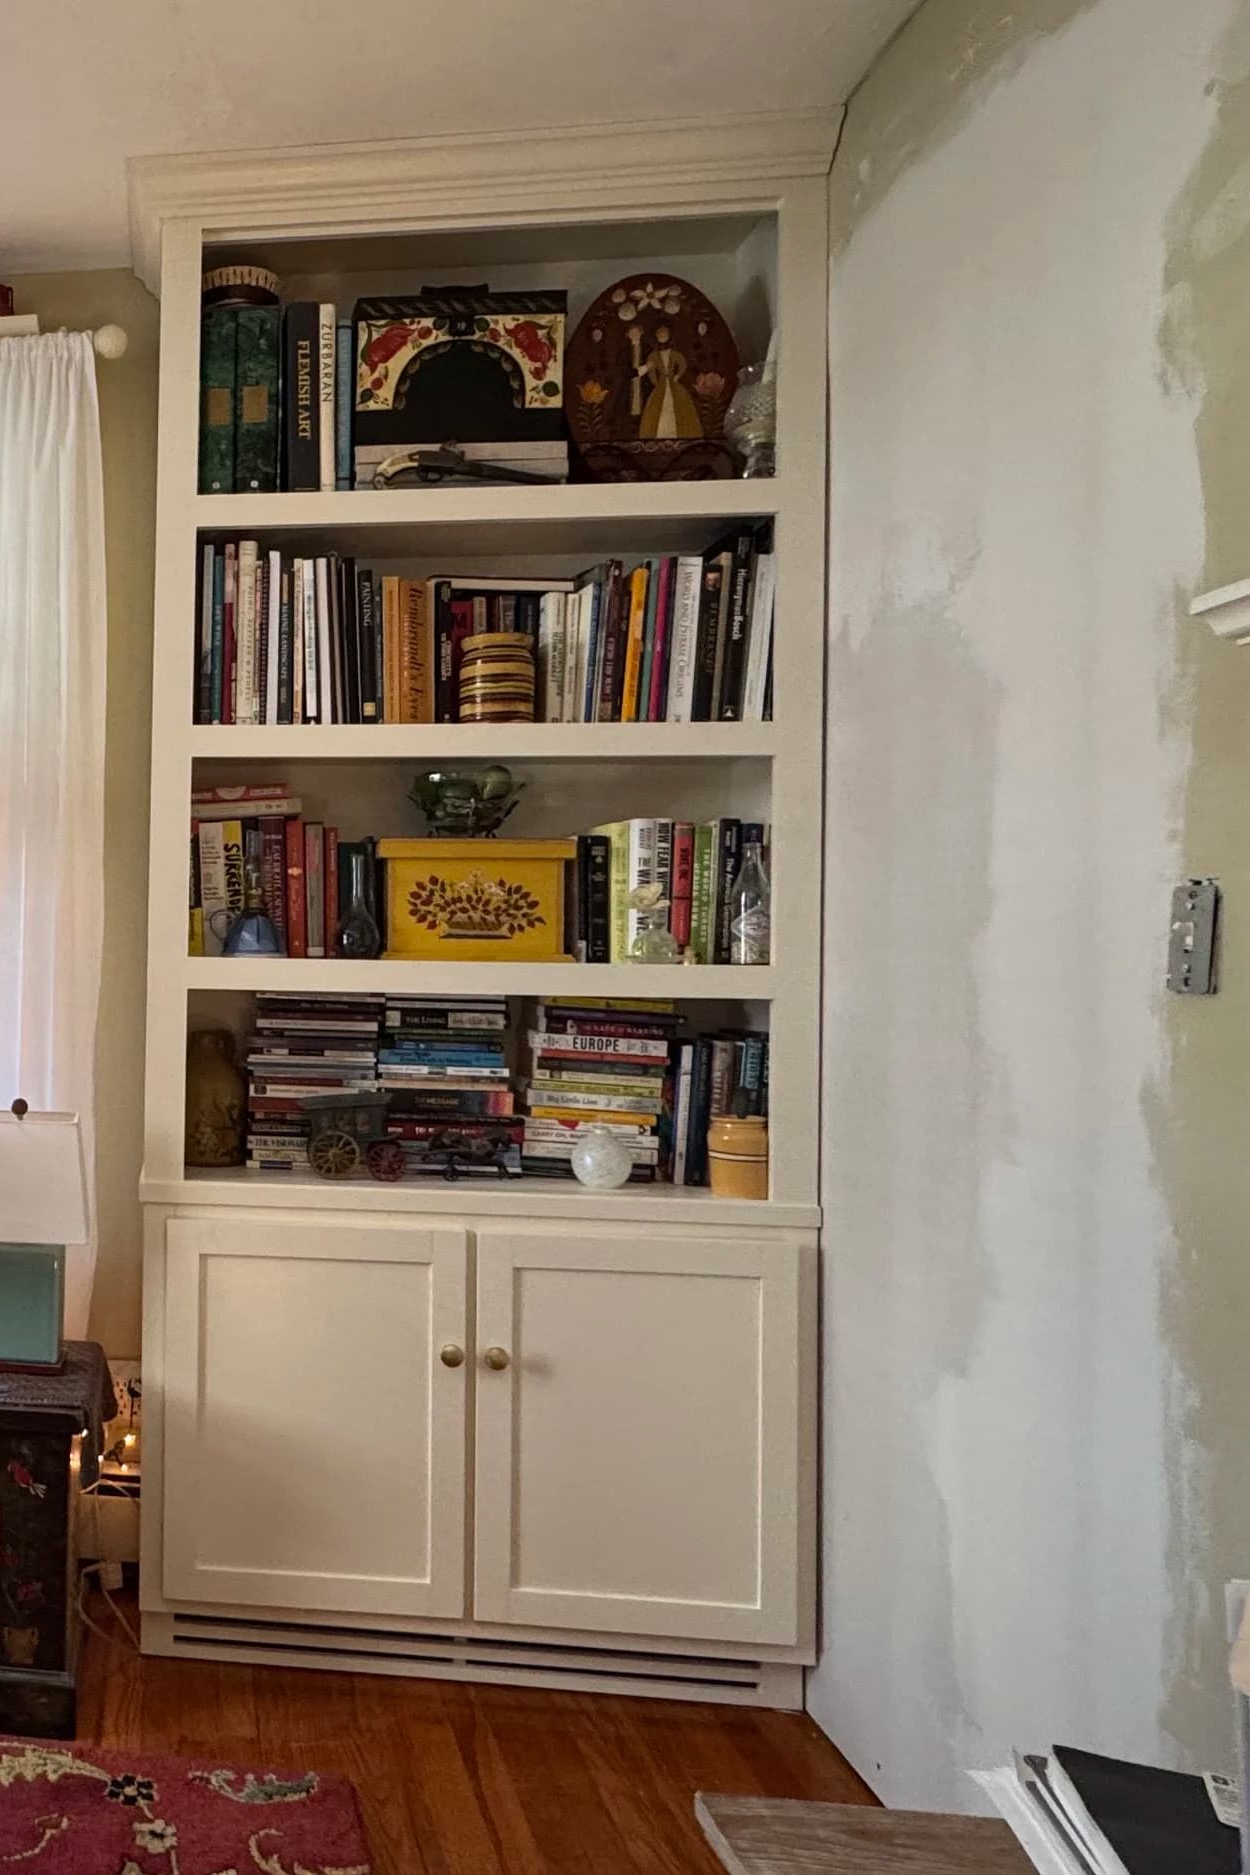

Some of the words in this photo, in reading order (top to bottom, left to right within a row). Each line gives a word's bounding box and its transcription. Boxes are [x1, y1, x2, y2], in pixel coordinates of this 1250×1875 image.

[298, 340, 311, 405] FLEMISH
[321, 323, 334, 403] ZURBARAN
[298, 410, 311, 440] ART
[362, 581, 375, 627] PAINTING
[408, 587, 425, 681] Rembrandt's
[732, 616, 746, 641] Bosch
[408, 686, 424, 721] Eyes
[657, 822, 670, 844] HOW
[656, 846, 669, 869] FEAR
[223, 842, 242, 913] SURRENDE
[700, 869, 710, 902] WORLD
[572, 1036, 620, 1053] EUROPE
